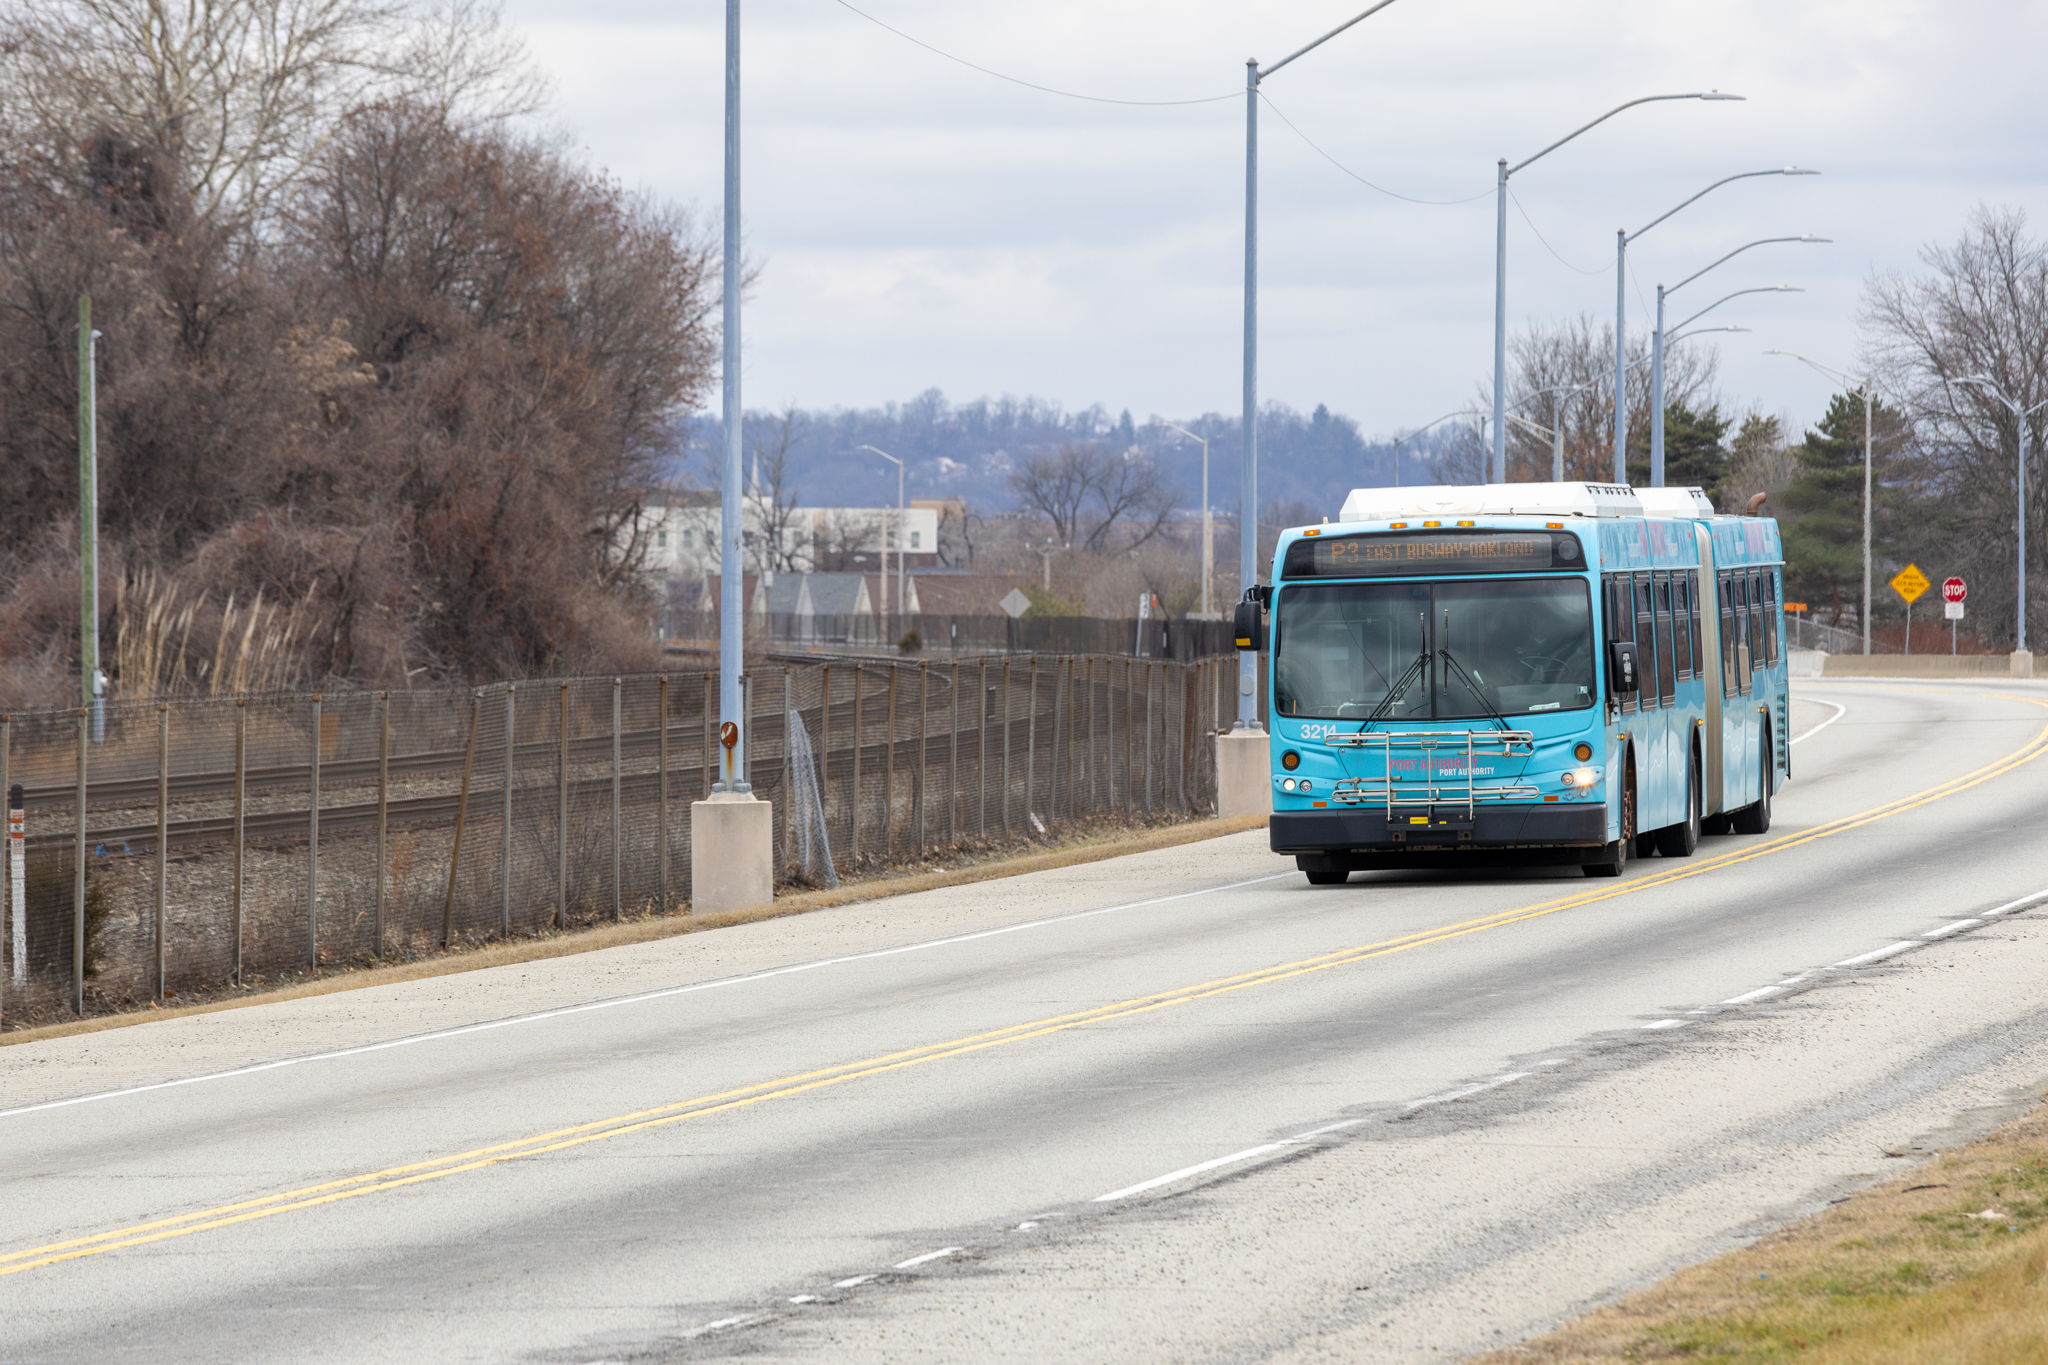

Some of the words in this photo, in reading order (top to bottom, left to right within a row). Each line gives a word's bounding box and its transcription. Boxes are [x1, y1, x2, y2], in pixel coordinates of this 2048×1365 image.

[1331, 542, 1359, 565] P3
[1366, 543, 1401, 561] EAST
[1944, 584, 1965, 596] STOP
[1300, 724, 1337, 739] 3214
[1389, 759, 1417, 771] PORT
[1439, 768, 1457, 777] PORT
